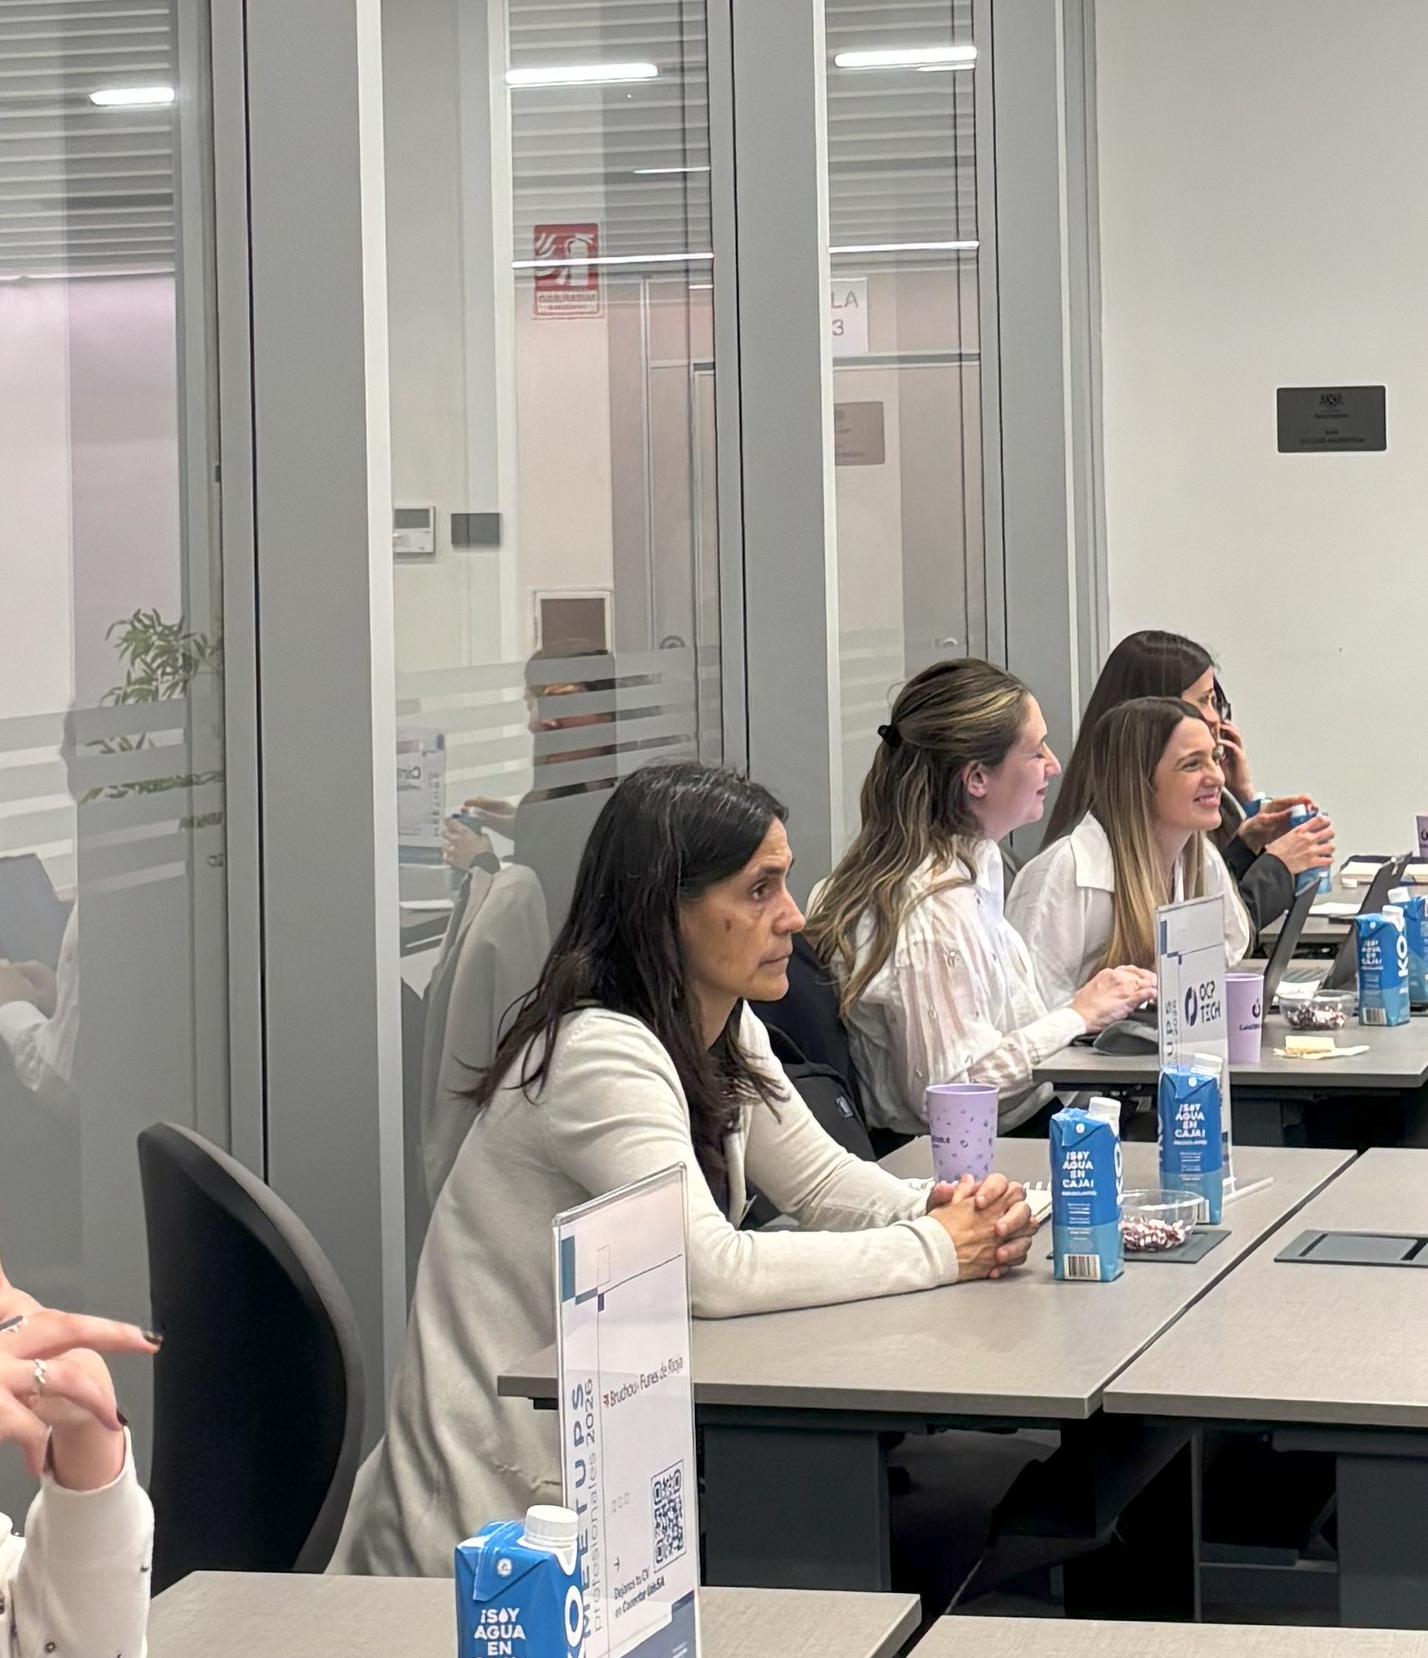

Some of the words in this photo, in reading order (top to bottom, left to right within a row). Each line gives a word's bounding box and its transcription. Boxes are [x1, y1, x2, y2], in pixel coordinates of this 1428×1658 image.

[831, 290, 859, 309] LA
[832, 319, 844, 336] 3
[1200, 999, 1221, 1024] TECH
[1175, 1111, 1205, 1121] AGUA
[1062, 1161, 1093, 1170] AGUA
[584, 1378, 596, 1447] 2026
[571, 1383, 592, 1639] MEETUPS
[474, 1625, 526, 1640] AGUA
[487, 1641, 512, 1656] EN
